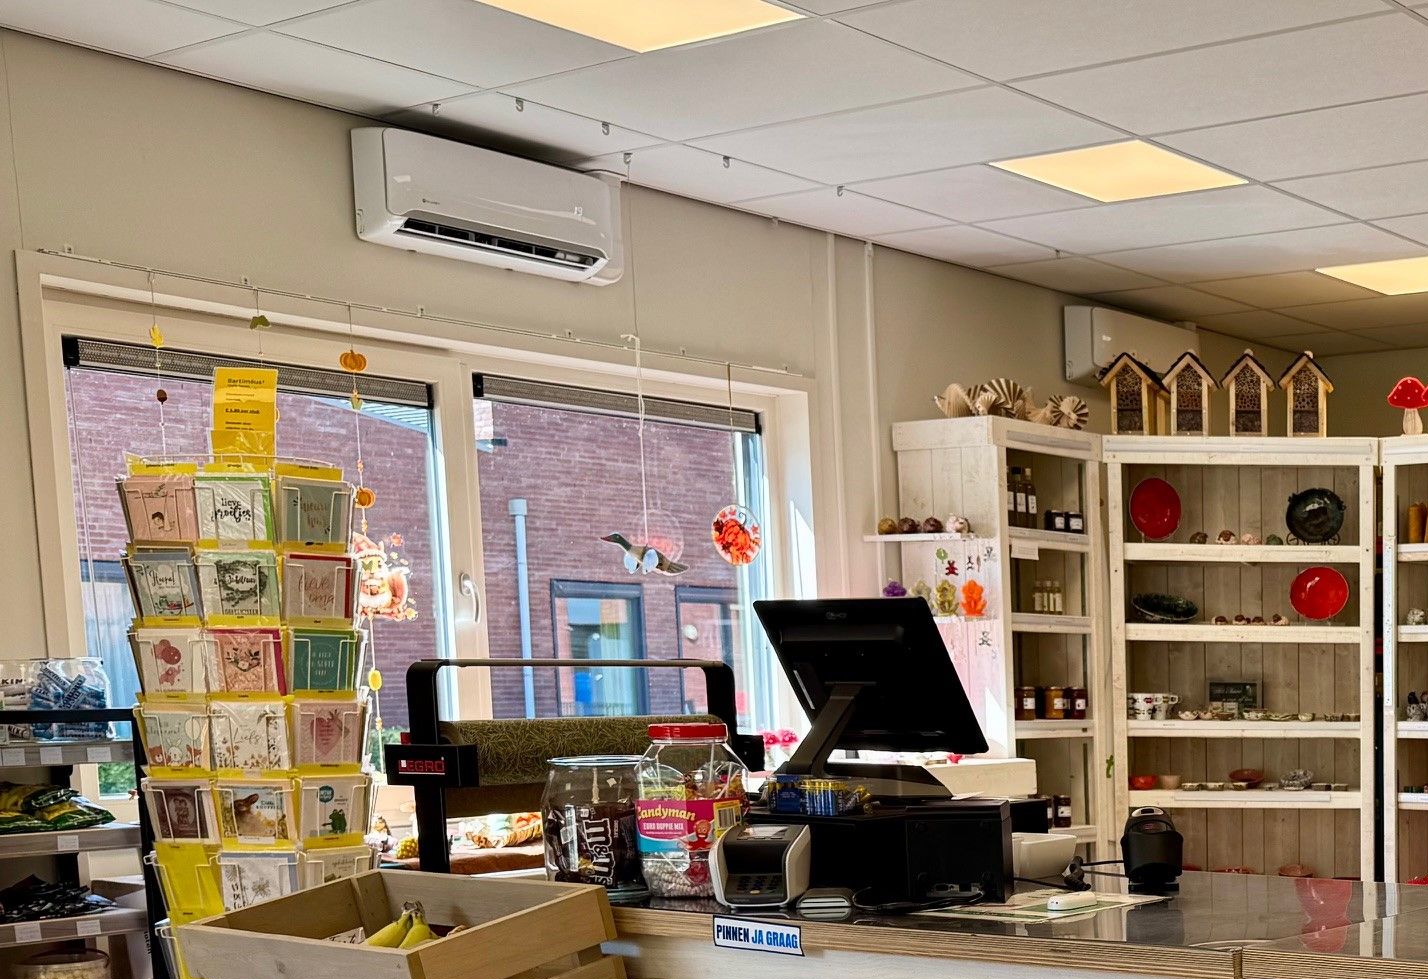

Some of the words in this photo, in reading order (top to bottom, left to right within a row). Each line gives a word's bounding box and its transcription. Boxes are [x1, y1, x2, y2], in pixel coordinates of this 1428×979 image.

[716, 924, 750, 943] PINNEN
[751, 929, 764, 945] JA
[766, 931, 798, 948] GRAAG
